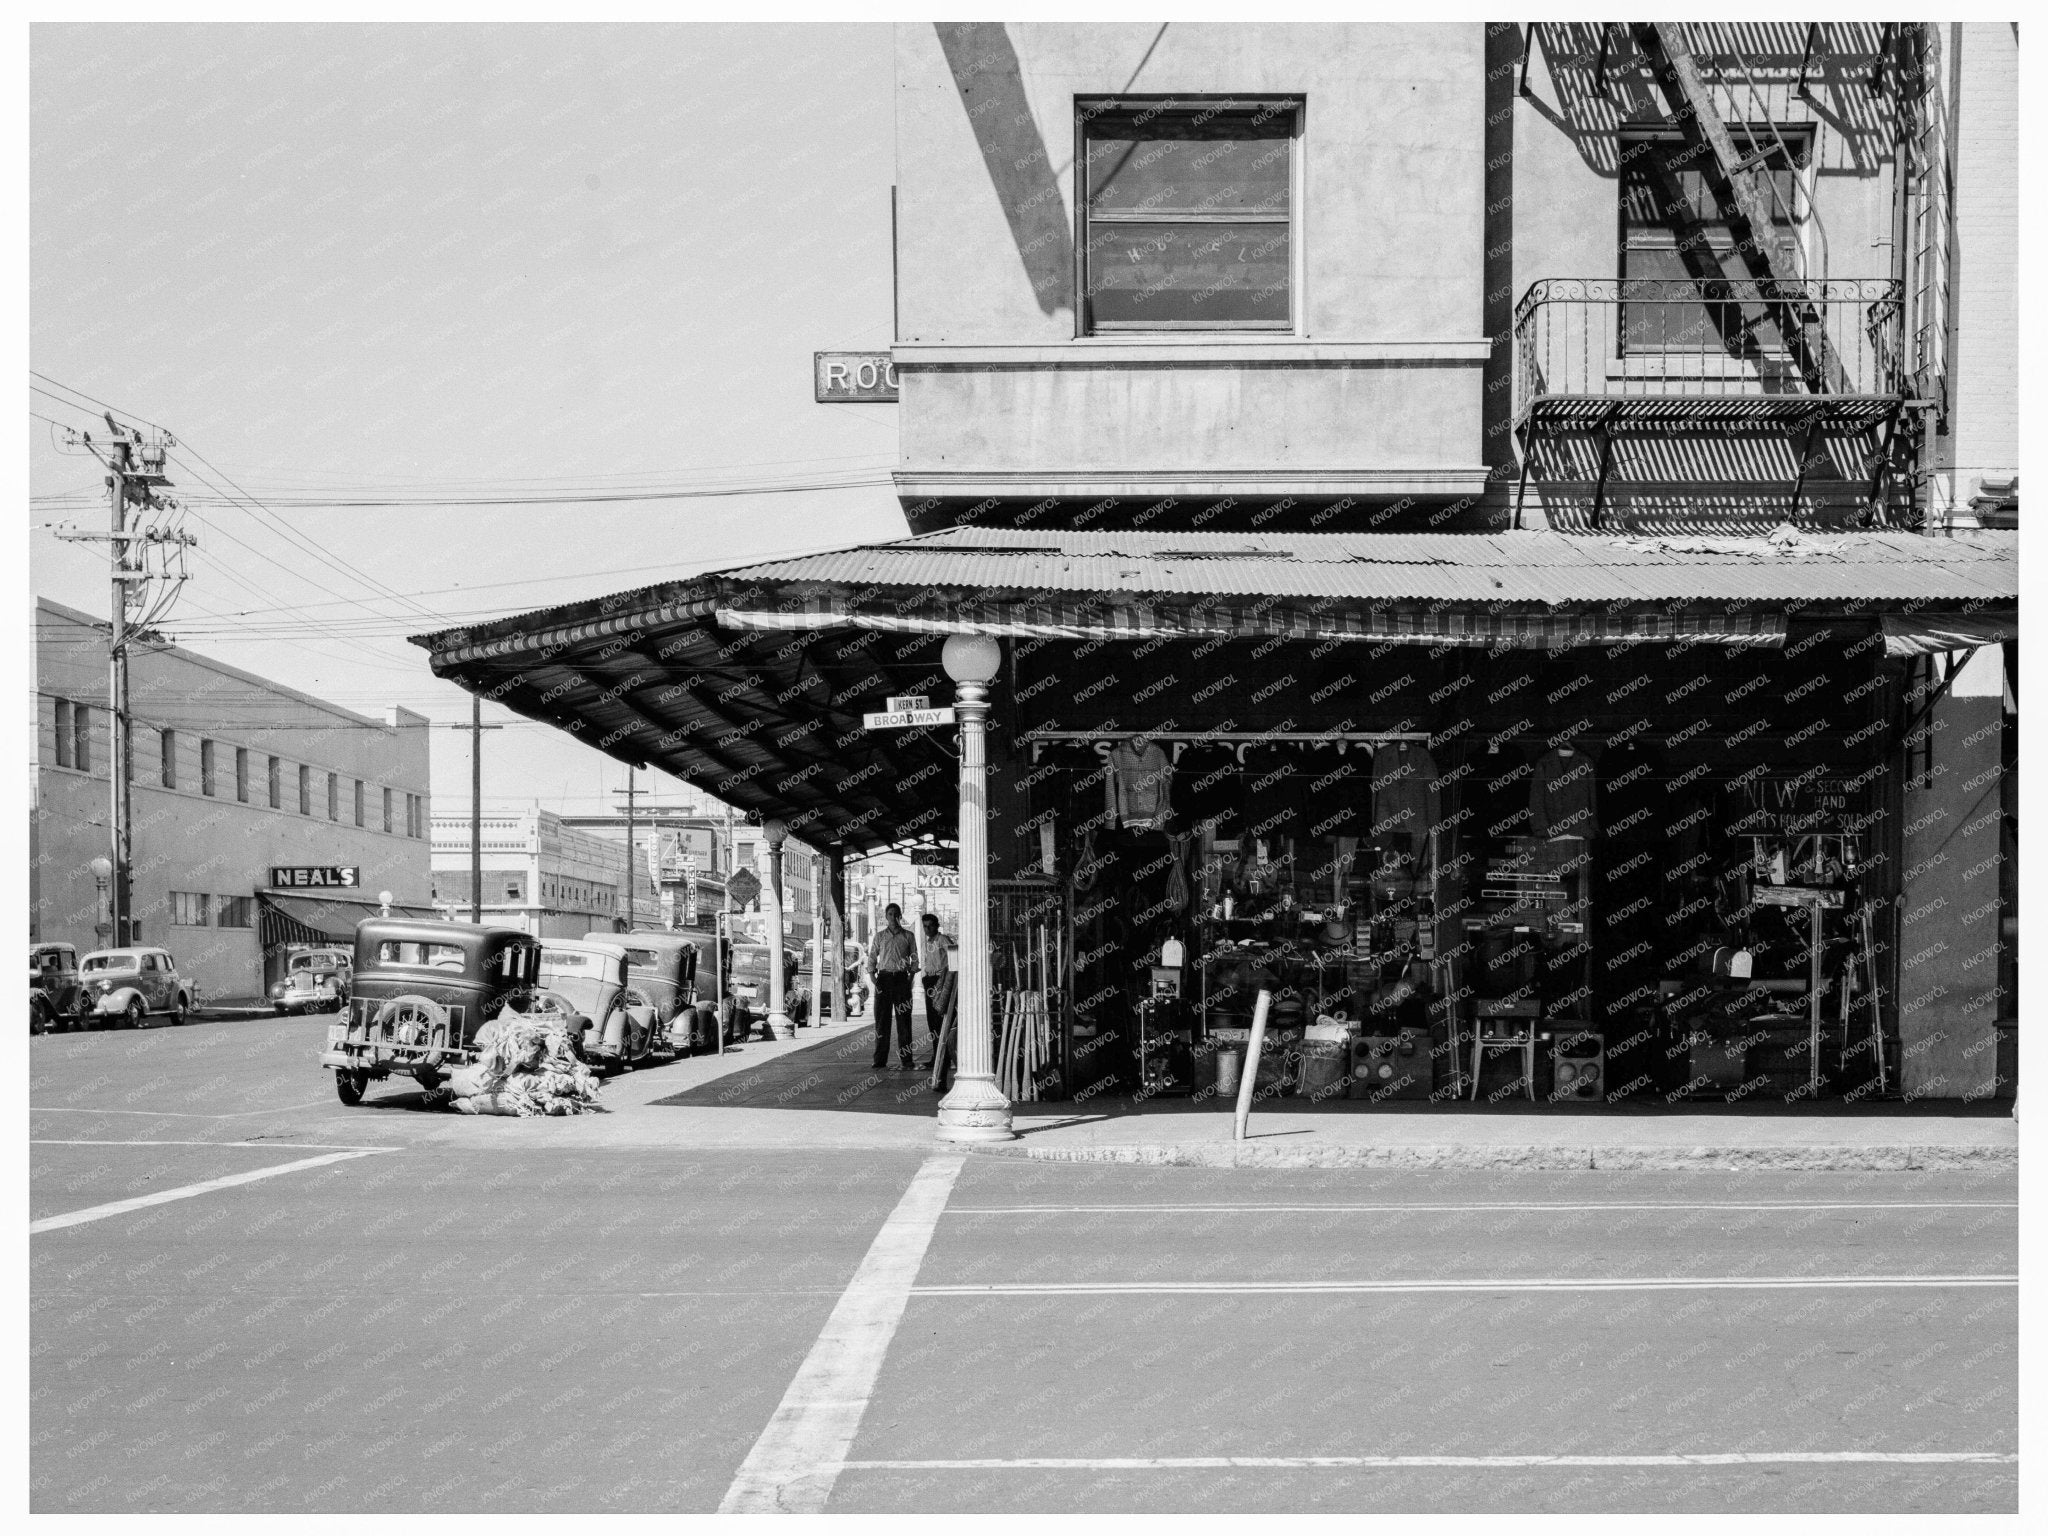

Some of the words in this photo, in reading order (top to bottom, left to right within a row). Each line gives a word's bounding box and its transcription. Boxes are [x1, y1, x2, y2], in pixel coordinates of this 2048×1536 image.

[898, 699, 913, 710] KERN
[873, 711, 942, 726] BROADWAY
[1814, 795, 1846, 809] HAND
[277, 868, 354, 886] NEAL'S
